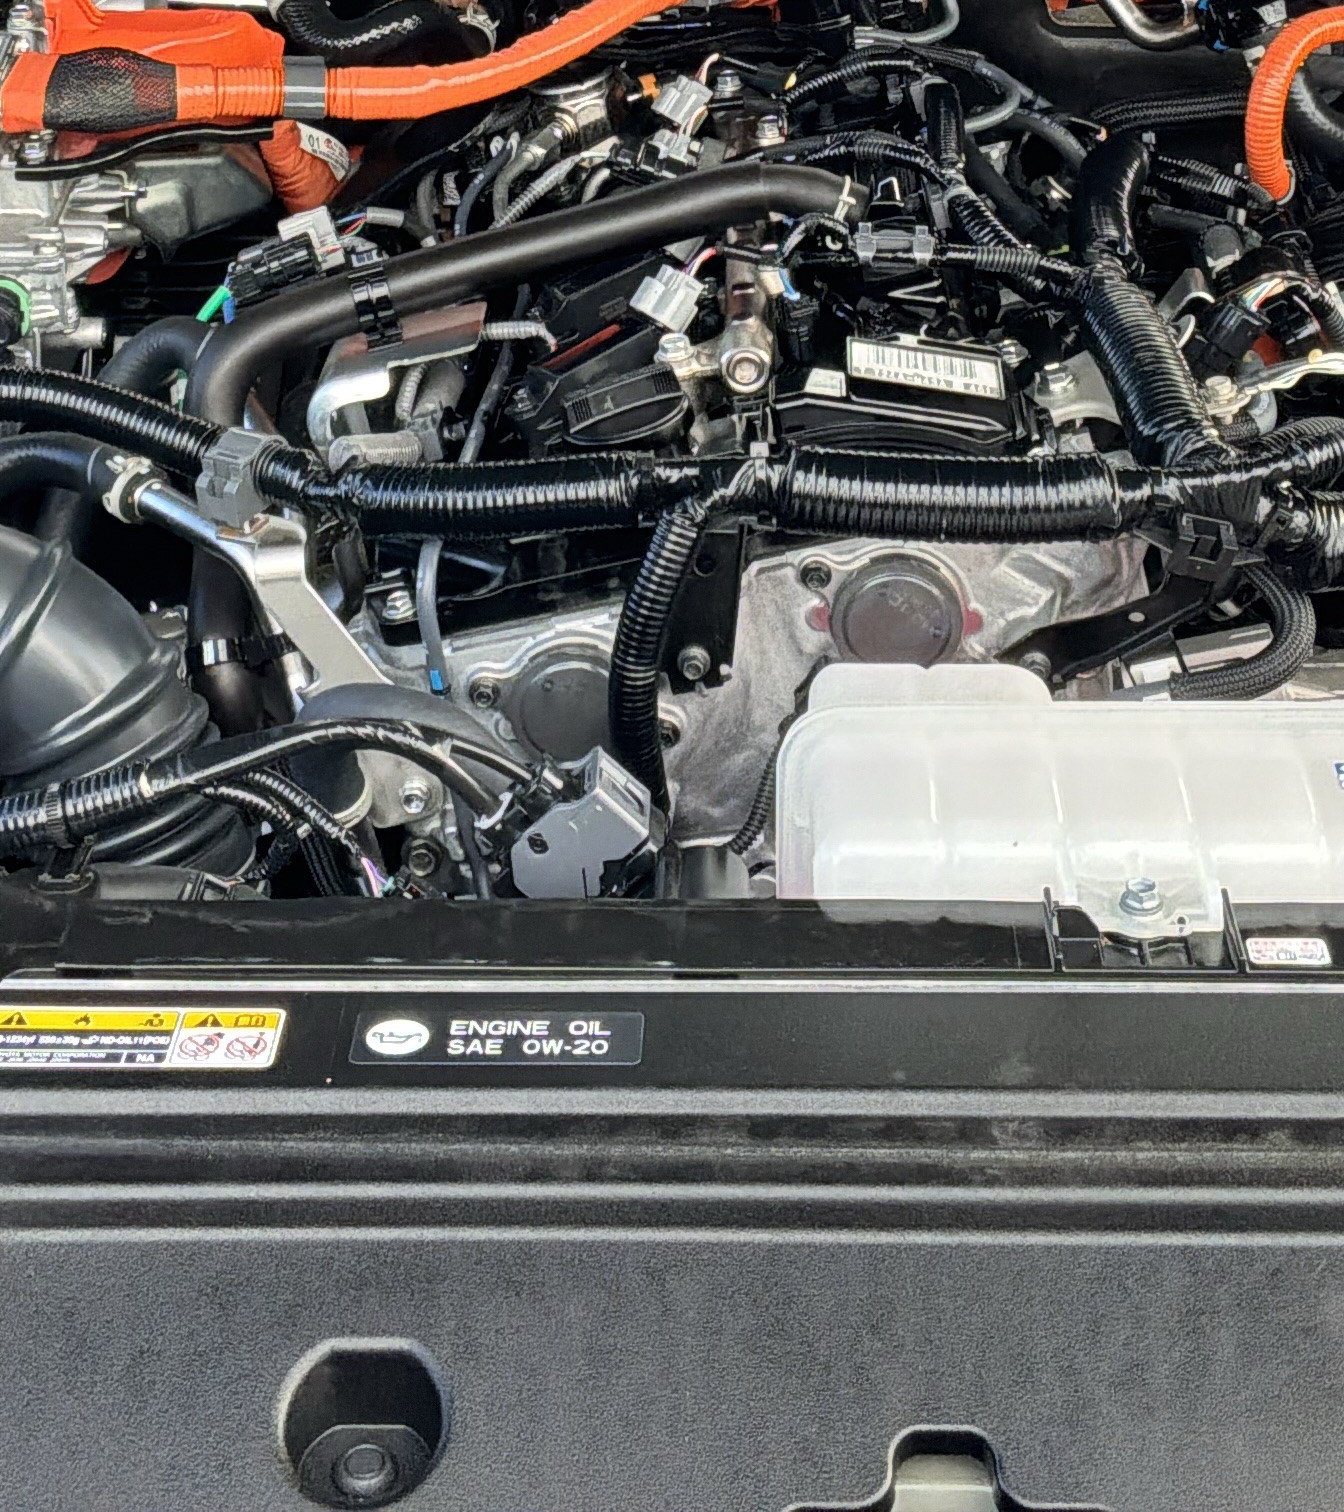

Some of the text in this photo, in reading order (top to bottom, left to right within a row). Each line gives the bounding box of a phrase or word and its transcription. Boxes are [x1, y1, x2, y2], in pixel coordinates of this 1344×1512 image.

[449, 1020, 612, 1037] ENGINE OIL
[446, 1038, 610, 1056] SAE 0W-20
